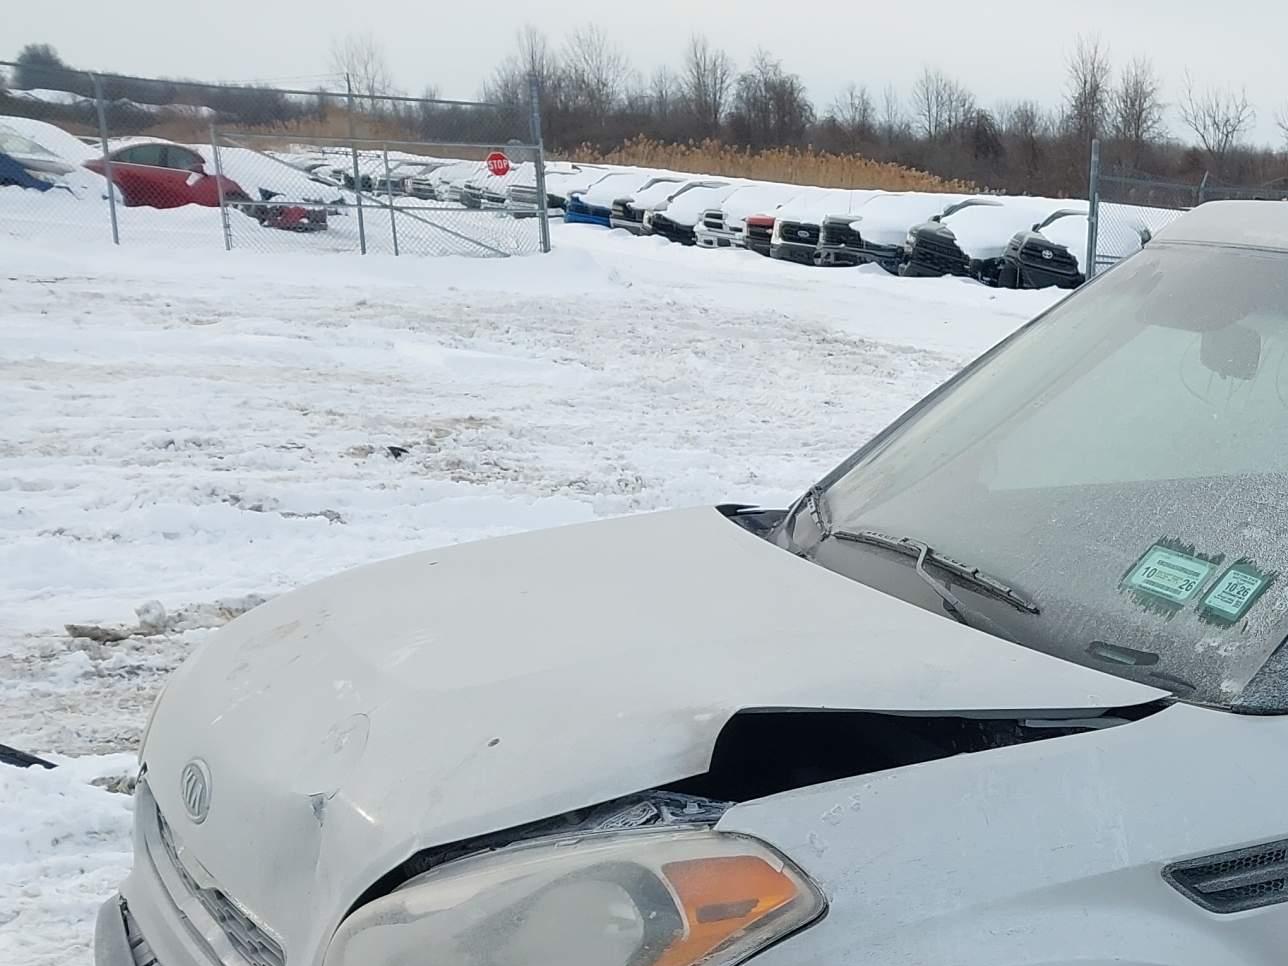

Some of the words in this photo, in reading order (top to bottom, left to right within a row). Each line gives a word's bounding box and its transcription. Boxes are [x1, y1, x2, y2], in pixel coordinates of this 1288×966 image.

[488, 159, 508, 169] STOP
[1142, 566, 1158, 579] 10
[1178, 578, 1197, 593] 26
